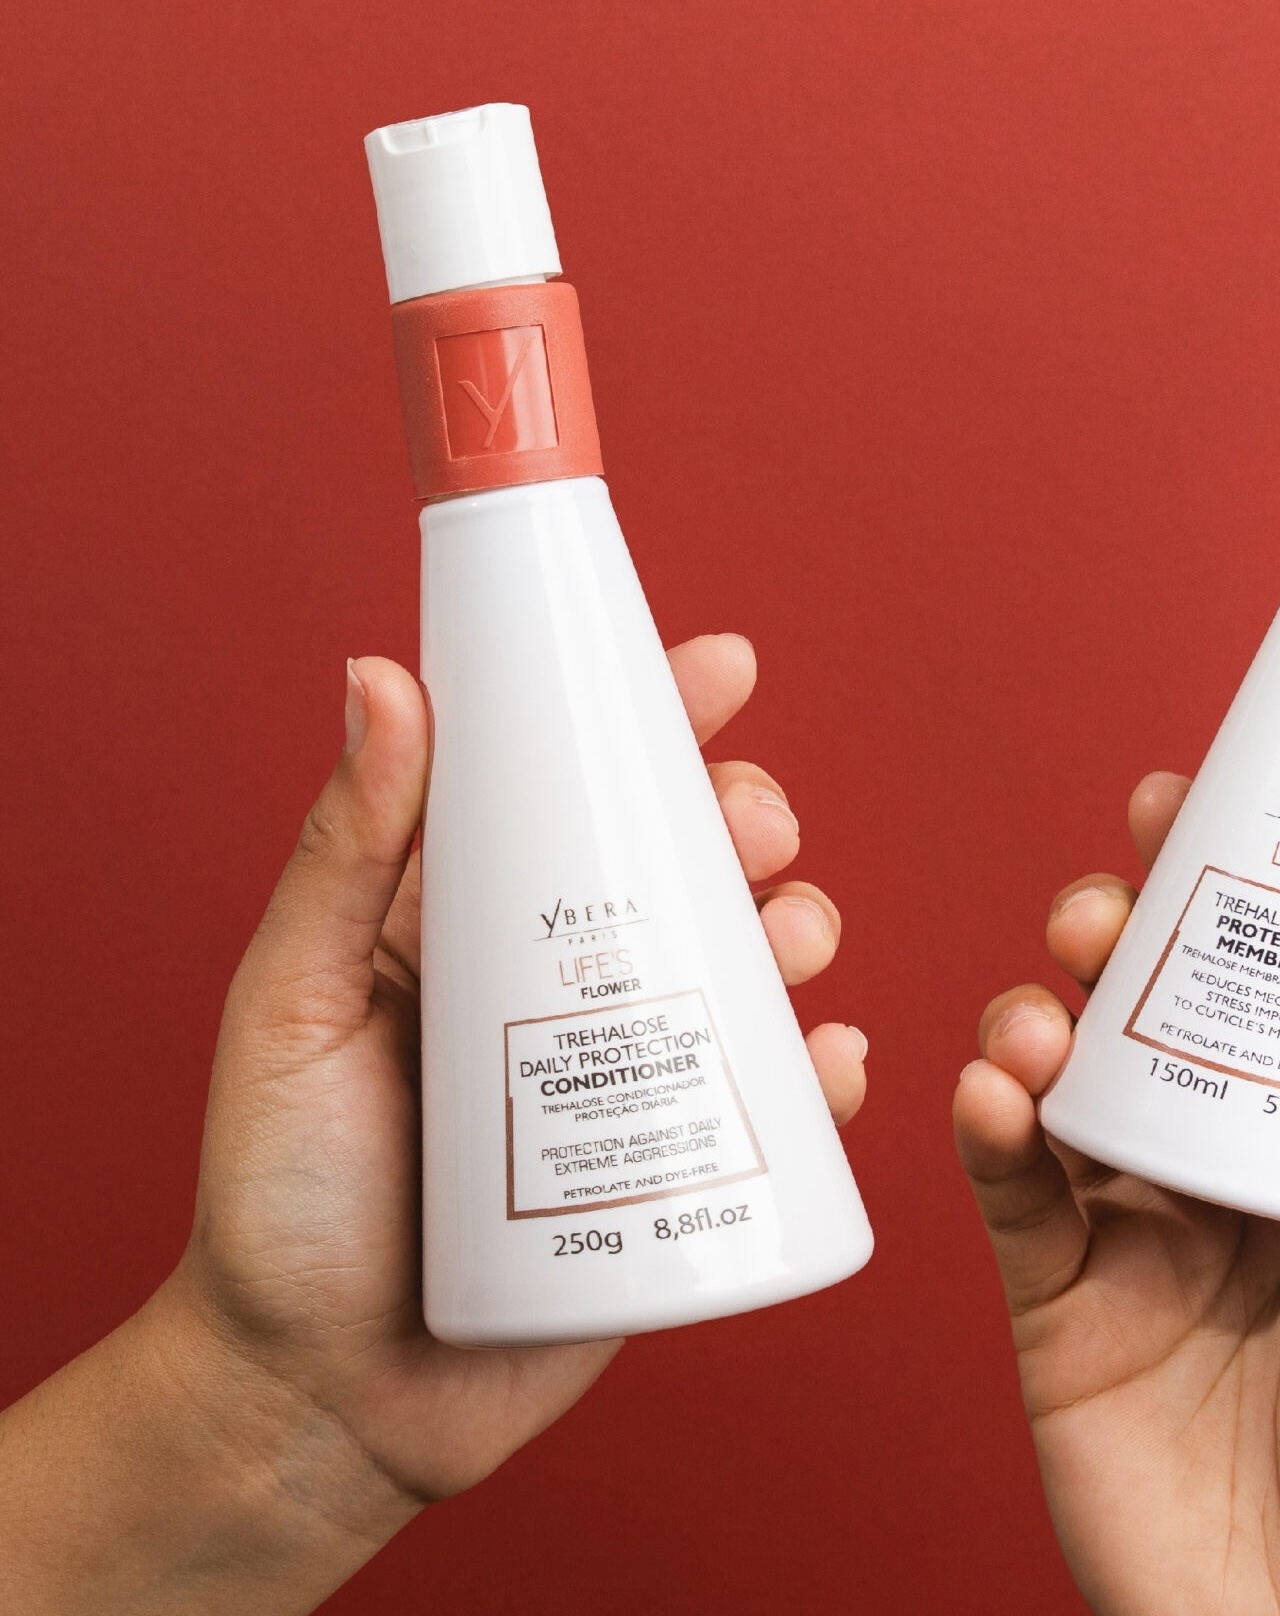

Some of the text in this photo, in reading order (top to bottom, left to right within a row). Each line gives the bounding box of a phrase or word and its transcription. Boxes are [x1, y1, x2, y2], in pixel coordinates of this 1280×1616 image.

[540, 898, 638, 938] YBERA
[568, 930, 618, 946] PARIS
[559, 949, 634, 986] LIFE'S
[1182, 945, 1237, 971] TREHALOSE
[581, 978, 642, 999] FLOWER
[1191, 970, 1252, 997] REDUCES
[1174, 995, 1193, 1011] TO
[1195, 1003, 1266, 1034] CUTICLE'S
[1206, 991, 1251, 1015] STRESS
[553, 1015, 669, 1050] TREHALOSE
[1160, 1022, 1237, 1057] PETROLATE
[1239, 1050, 1274, 1066] AND
[520, 1028, 712, 1078] DAILY PROTECTION
[540, 1053, 699, 1096] CONDITIONER
[1149, 1057, 1229, 1100] 150ml
[541, 1076, 706, 1115] TREHALOSE CONDICIONADOR
[574, 1096, 679, 1122] PROTEÇÃO DIÁRIA
[541, 1116, 722, 1161] PROTECTION AGAINST DAILY
[554, 1135, 717, 1176] EXTREME AGGRESSIONS
[563, 1162, 719, 1200] PETROLATE AND DYE-FREE
[552, 1229, 624, 1256] 250g
